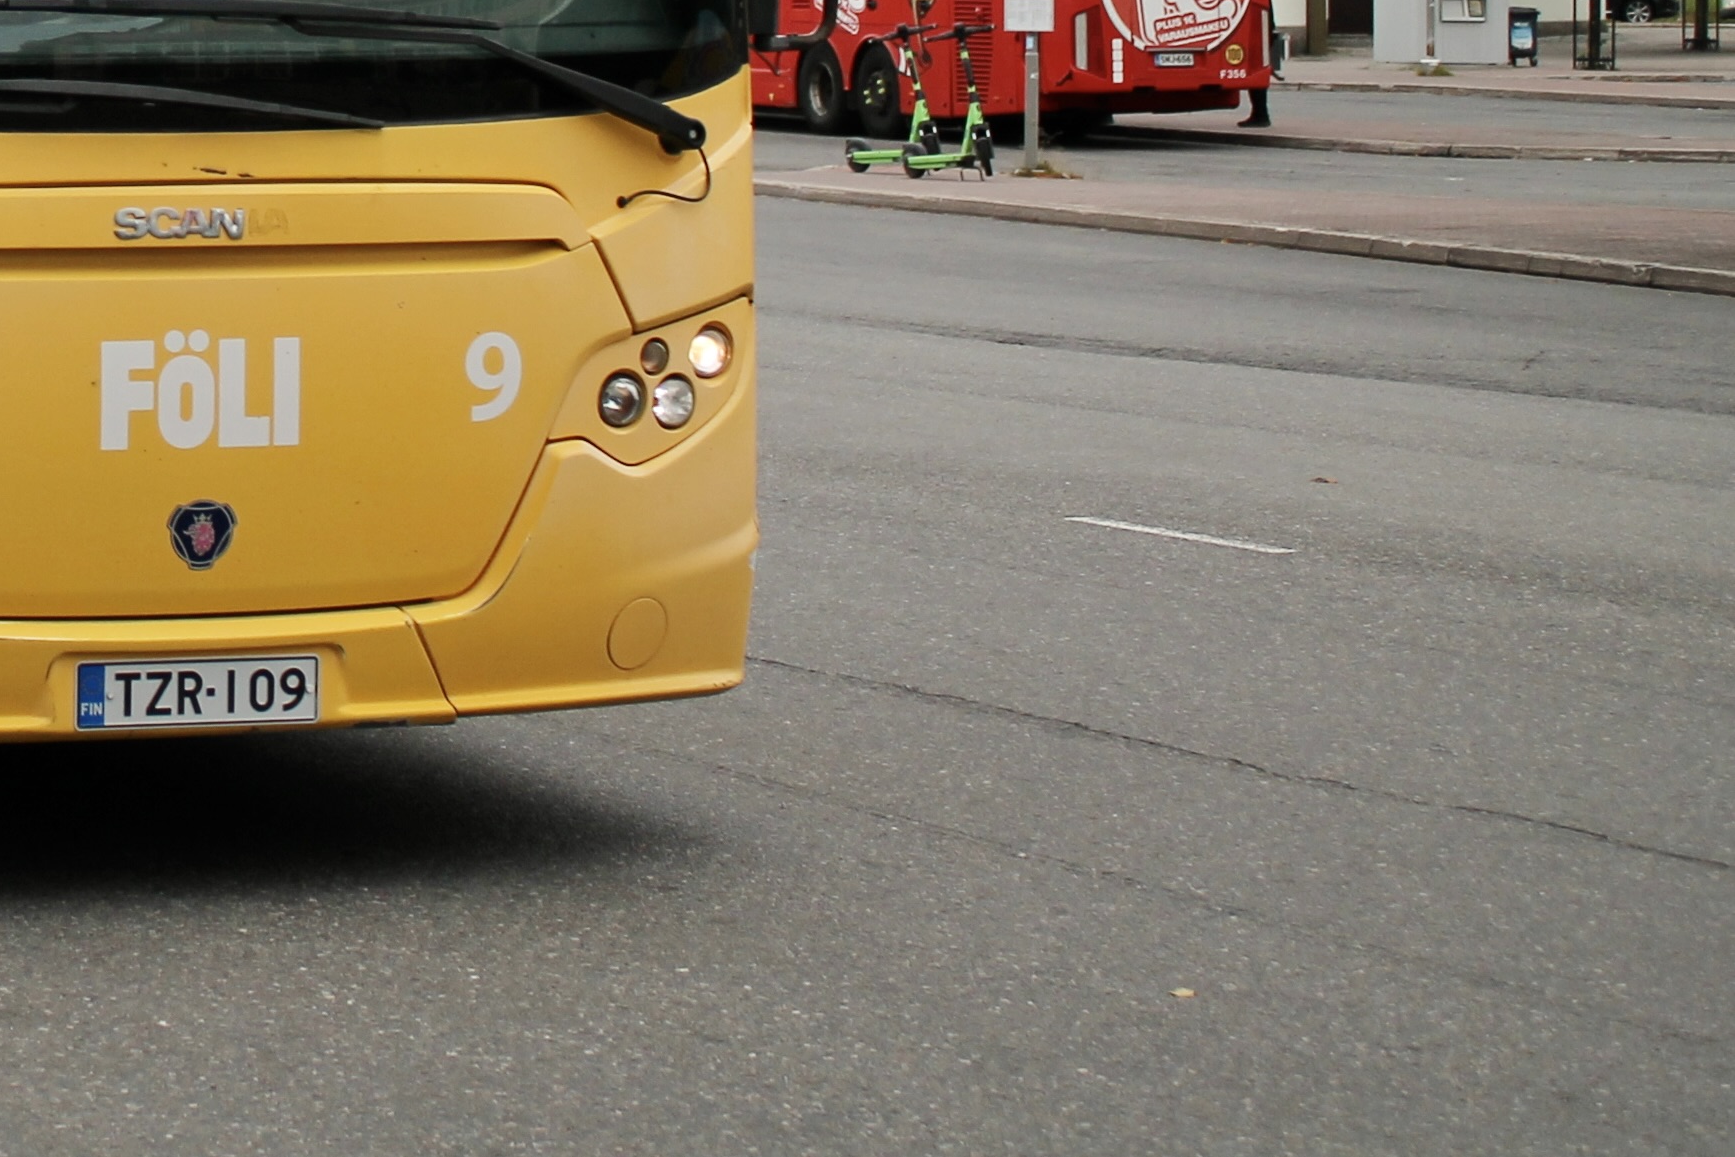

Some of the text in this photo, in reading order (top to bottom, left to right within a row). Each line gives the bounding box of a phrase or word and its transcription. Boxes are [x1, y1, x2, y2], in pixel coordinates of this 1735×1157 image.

[1155, 16, 1182, 31] PLUS
[1158, 18, 1229, 43] VARAUSMAKSU
[99, 328, 301, 451] FÖLI
[465, 330, 523, 423] 9
[80, 666, 307, 717] FIN TZR-109
